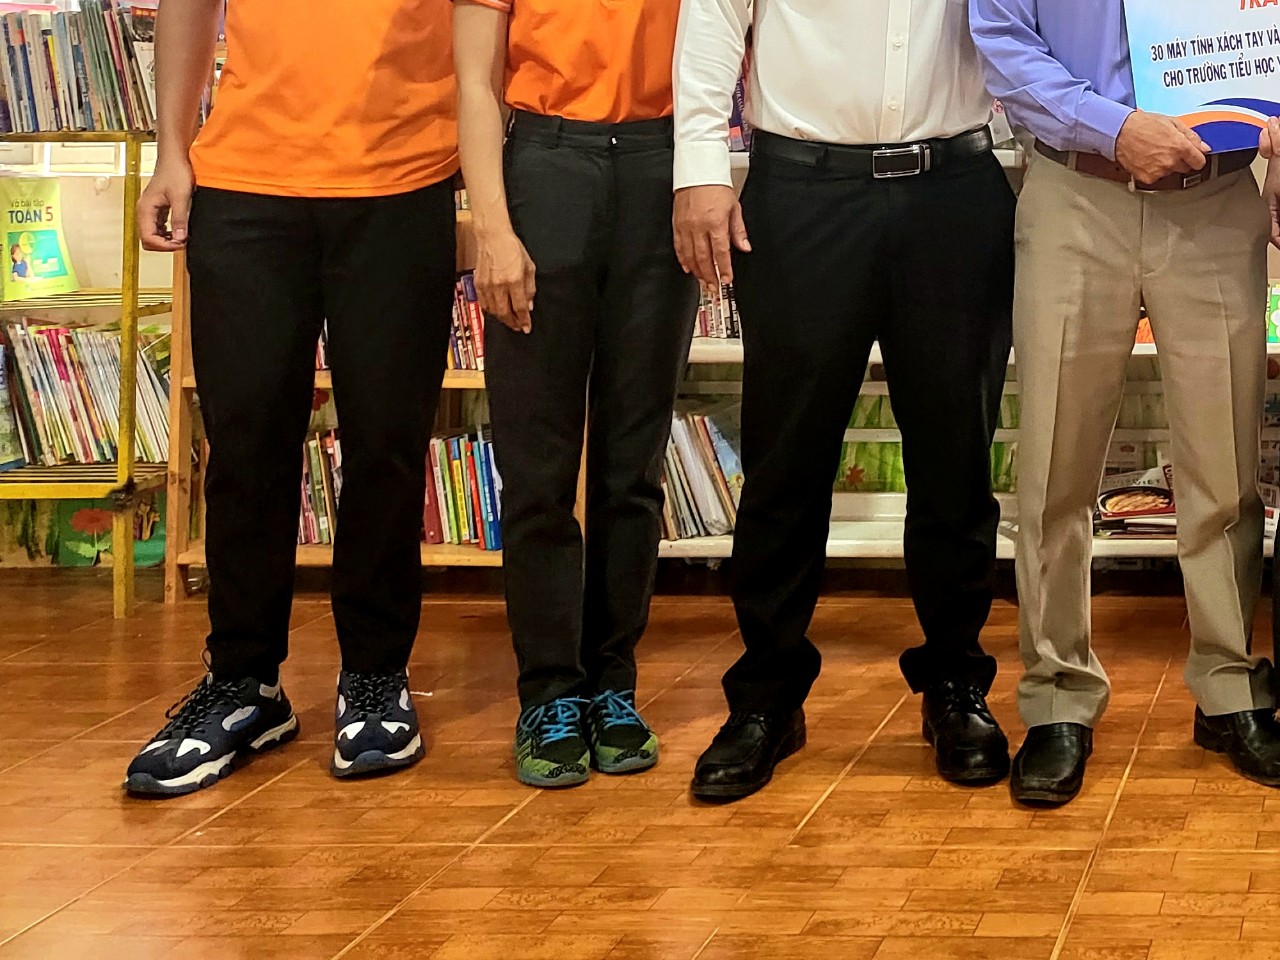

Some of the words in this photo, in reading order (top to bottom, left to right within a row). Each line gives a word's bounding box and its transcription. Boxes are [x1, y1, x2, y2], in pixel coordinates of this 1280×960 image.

[1151, 44, 1164, 62] 30
[1167, 37, 1188, 60] MÁY
[1190, 34, 1214, 57] TÍNH
[1217, 31, 1243, 54] XÁCH
[1245, 31, 1264, 48] TAY
[1266, 24, 1280, 45] VÀ
[1163, 69, 1184, 88] CHO
[1186, 62, 1227, 84] TRƯỜNG
[1229, 52, 1251, 79] TIỂU
[1254, 58, 1275, 79] HỌC
[8, 208, 43, 224] TOÁN
[45, 206, 54, 222] 5
